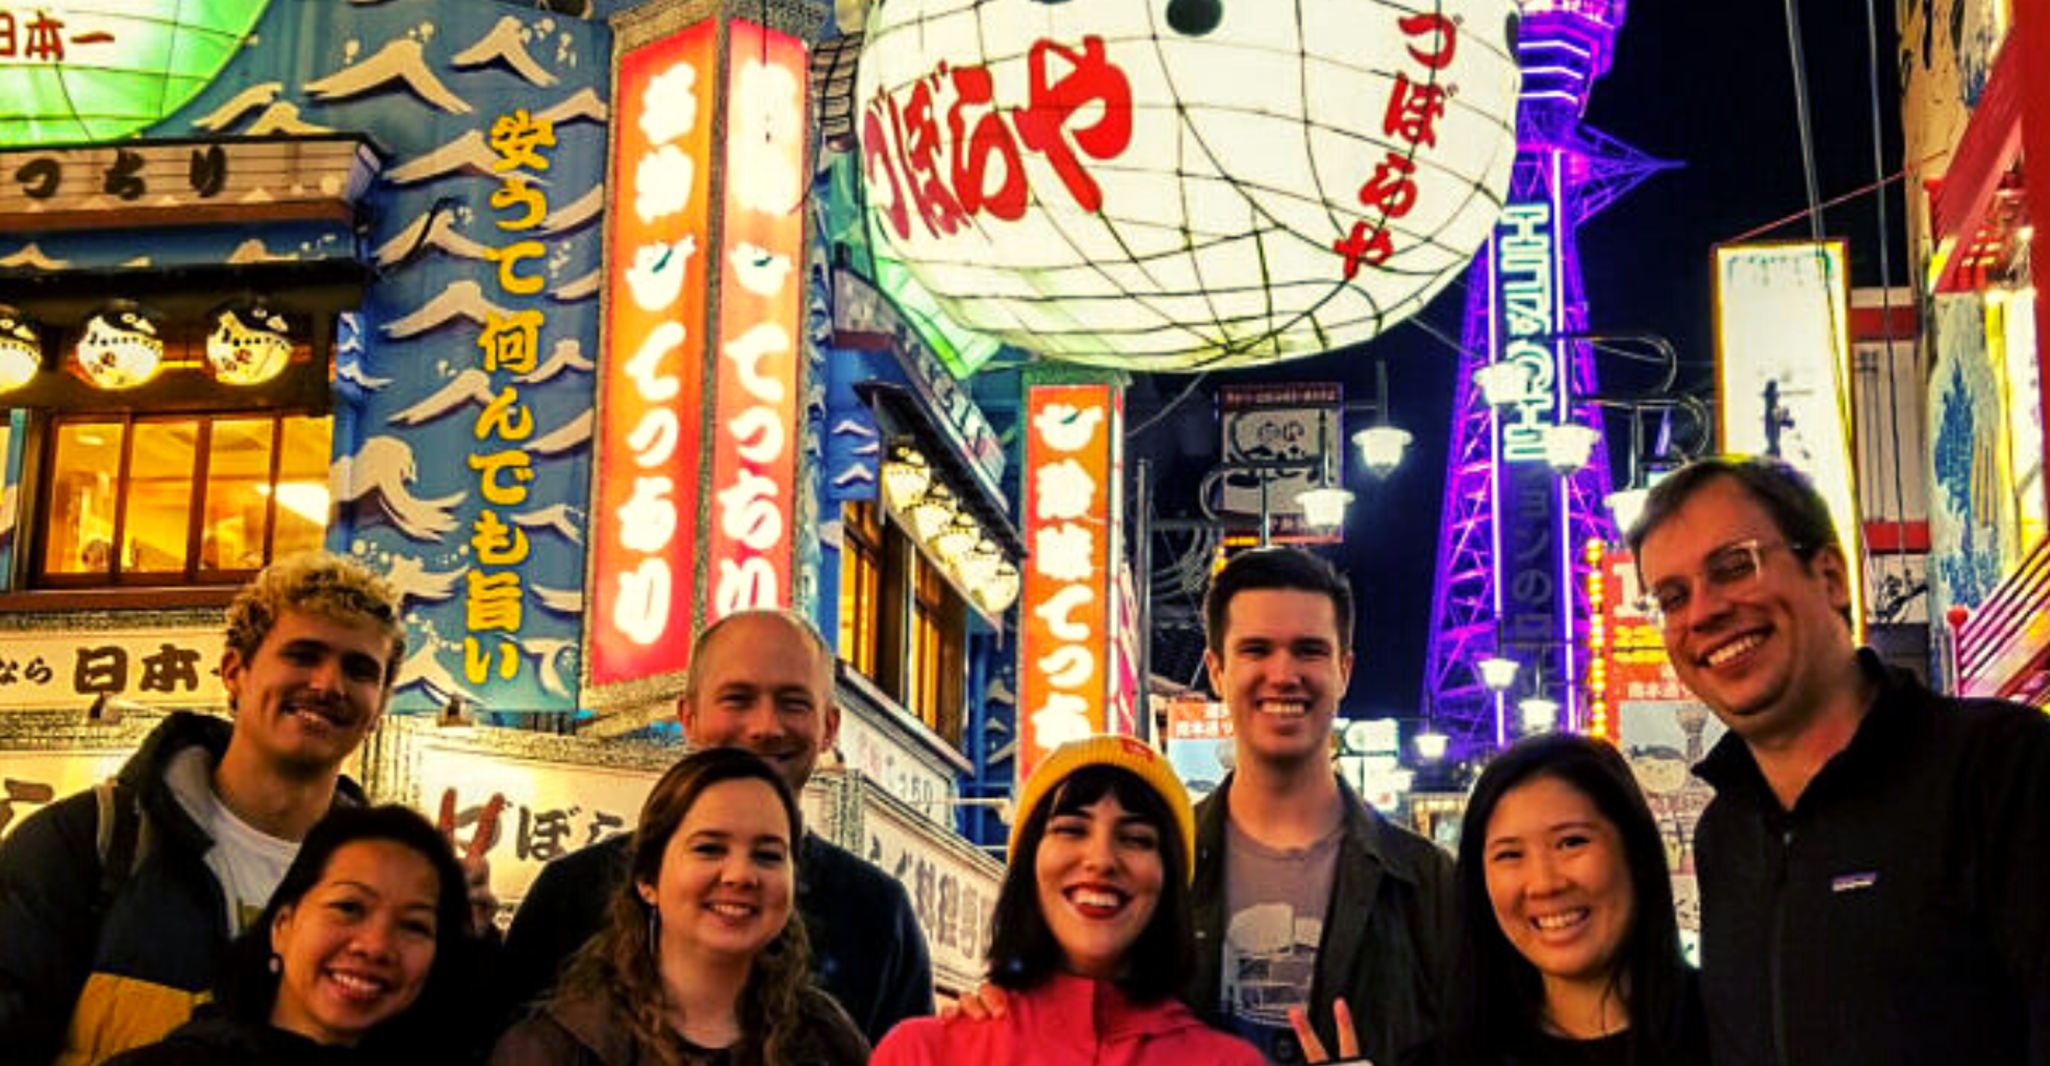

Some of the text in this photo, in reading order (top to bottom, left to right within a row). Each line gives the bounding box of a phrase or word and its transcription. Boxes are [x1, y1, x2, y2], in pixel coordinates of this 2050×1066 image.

[865, 35, 1133, 241] づぼらや
[1334, 12, 1465, 280] づぼらや
[1500, 203, 1555, 461] HITACHI
[74, 642, 224, 694] 日本
